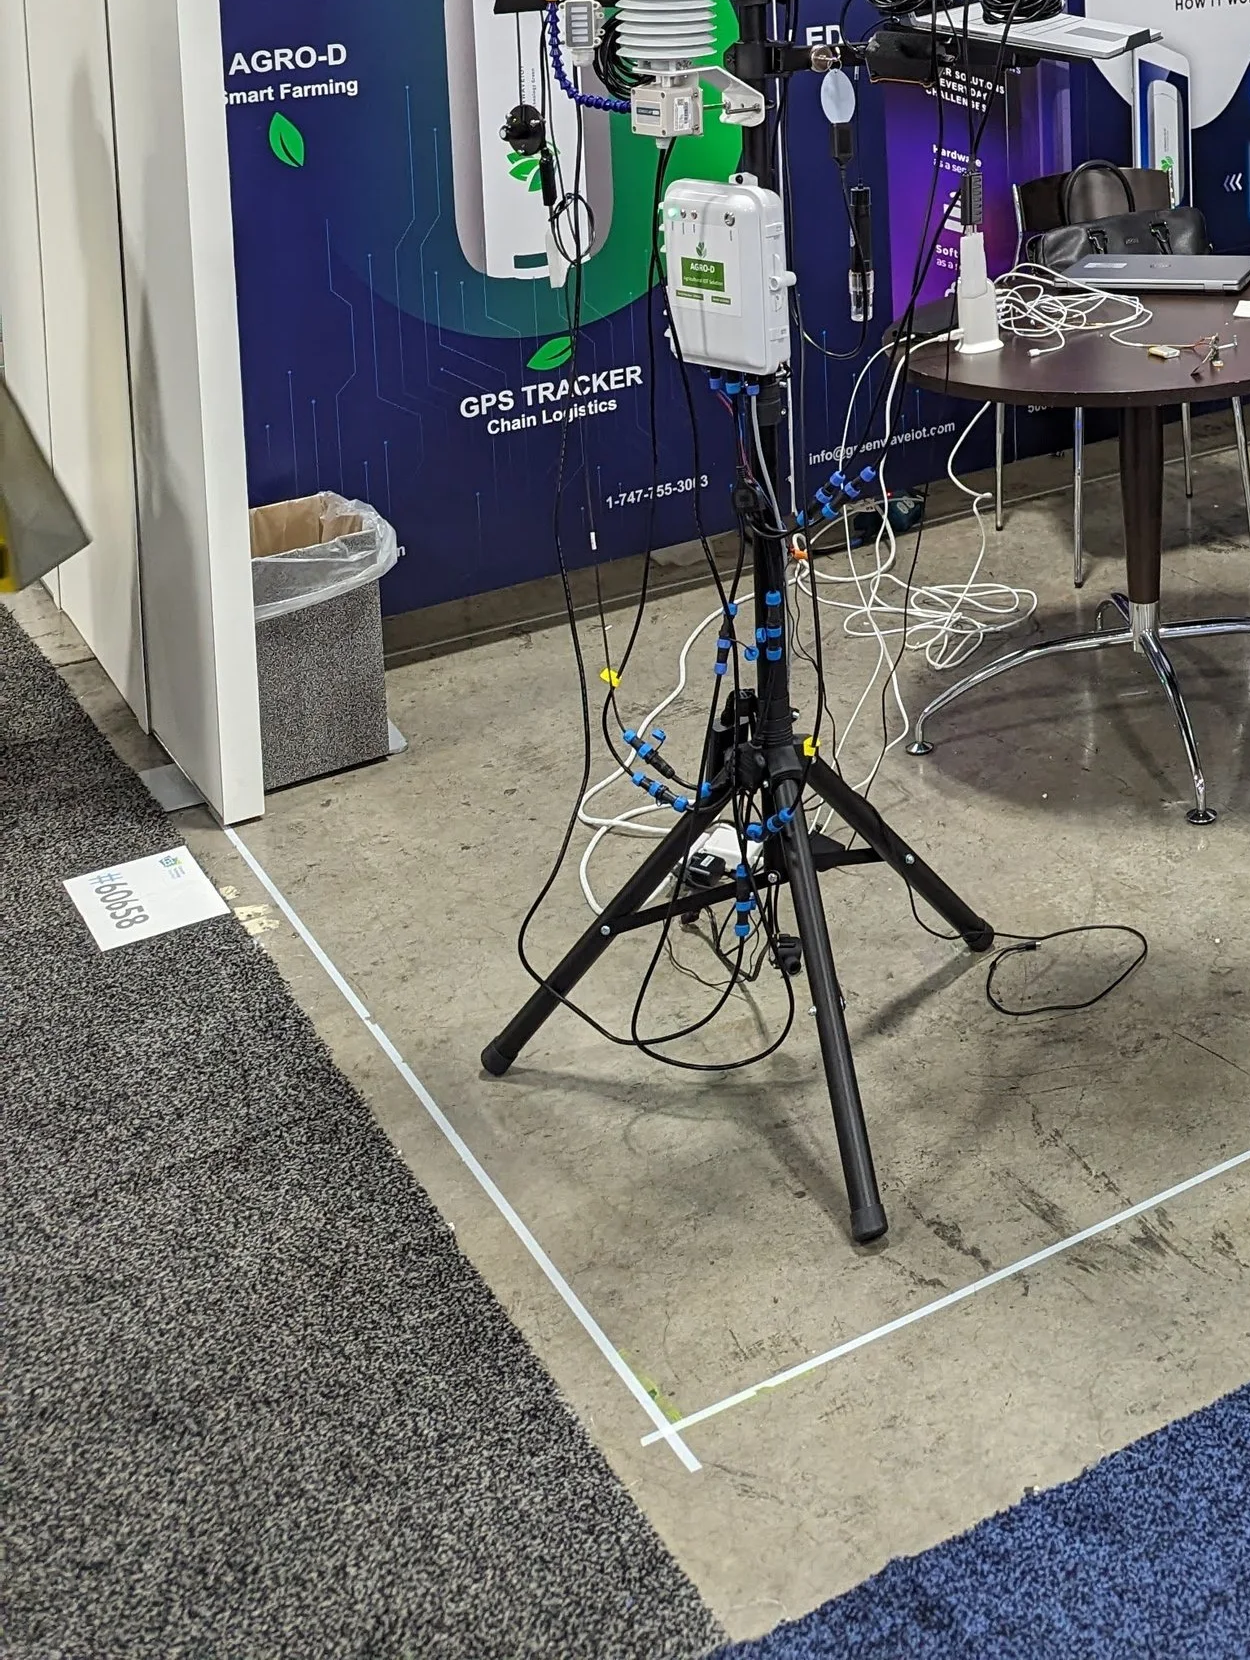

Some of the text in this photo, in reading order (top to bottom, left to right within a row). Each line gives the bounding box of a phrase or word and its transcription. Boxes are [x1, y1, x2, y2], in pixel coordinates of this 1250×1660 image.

[228, 43, 347, 76] AGRO-D
[279, 78, 358, 101] Farming
[690, 262, 715, 274] AGRO-D
[460, 365, 643, 418] GPS TRACKER
[487, 414, 537, 434] Chain
[88, 871, 149, 930] #60658
